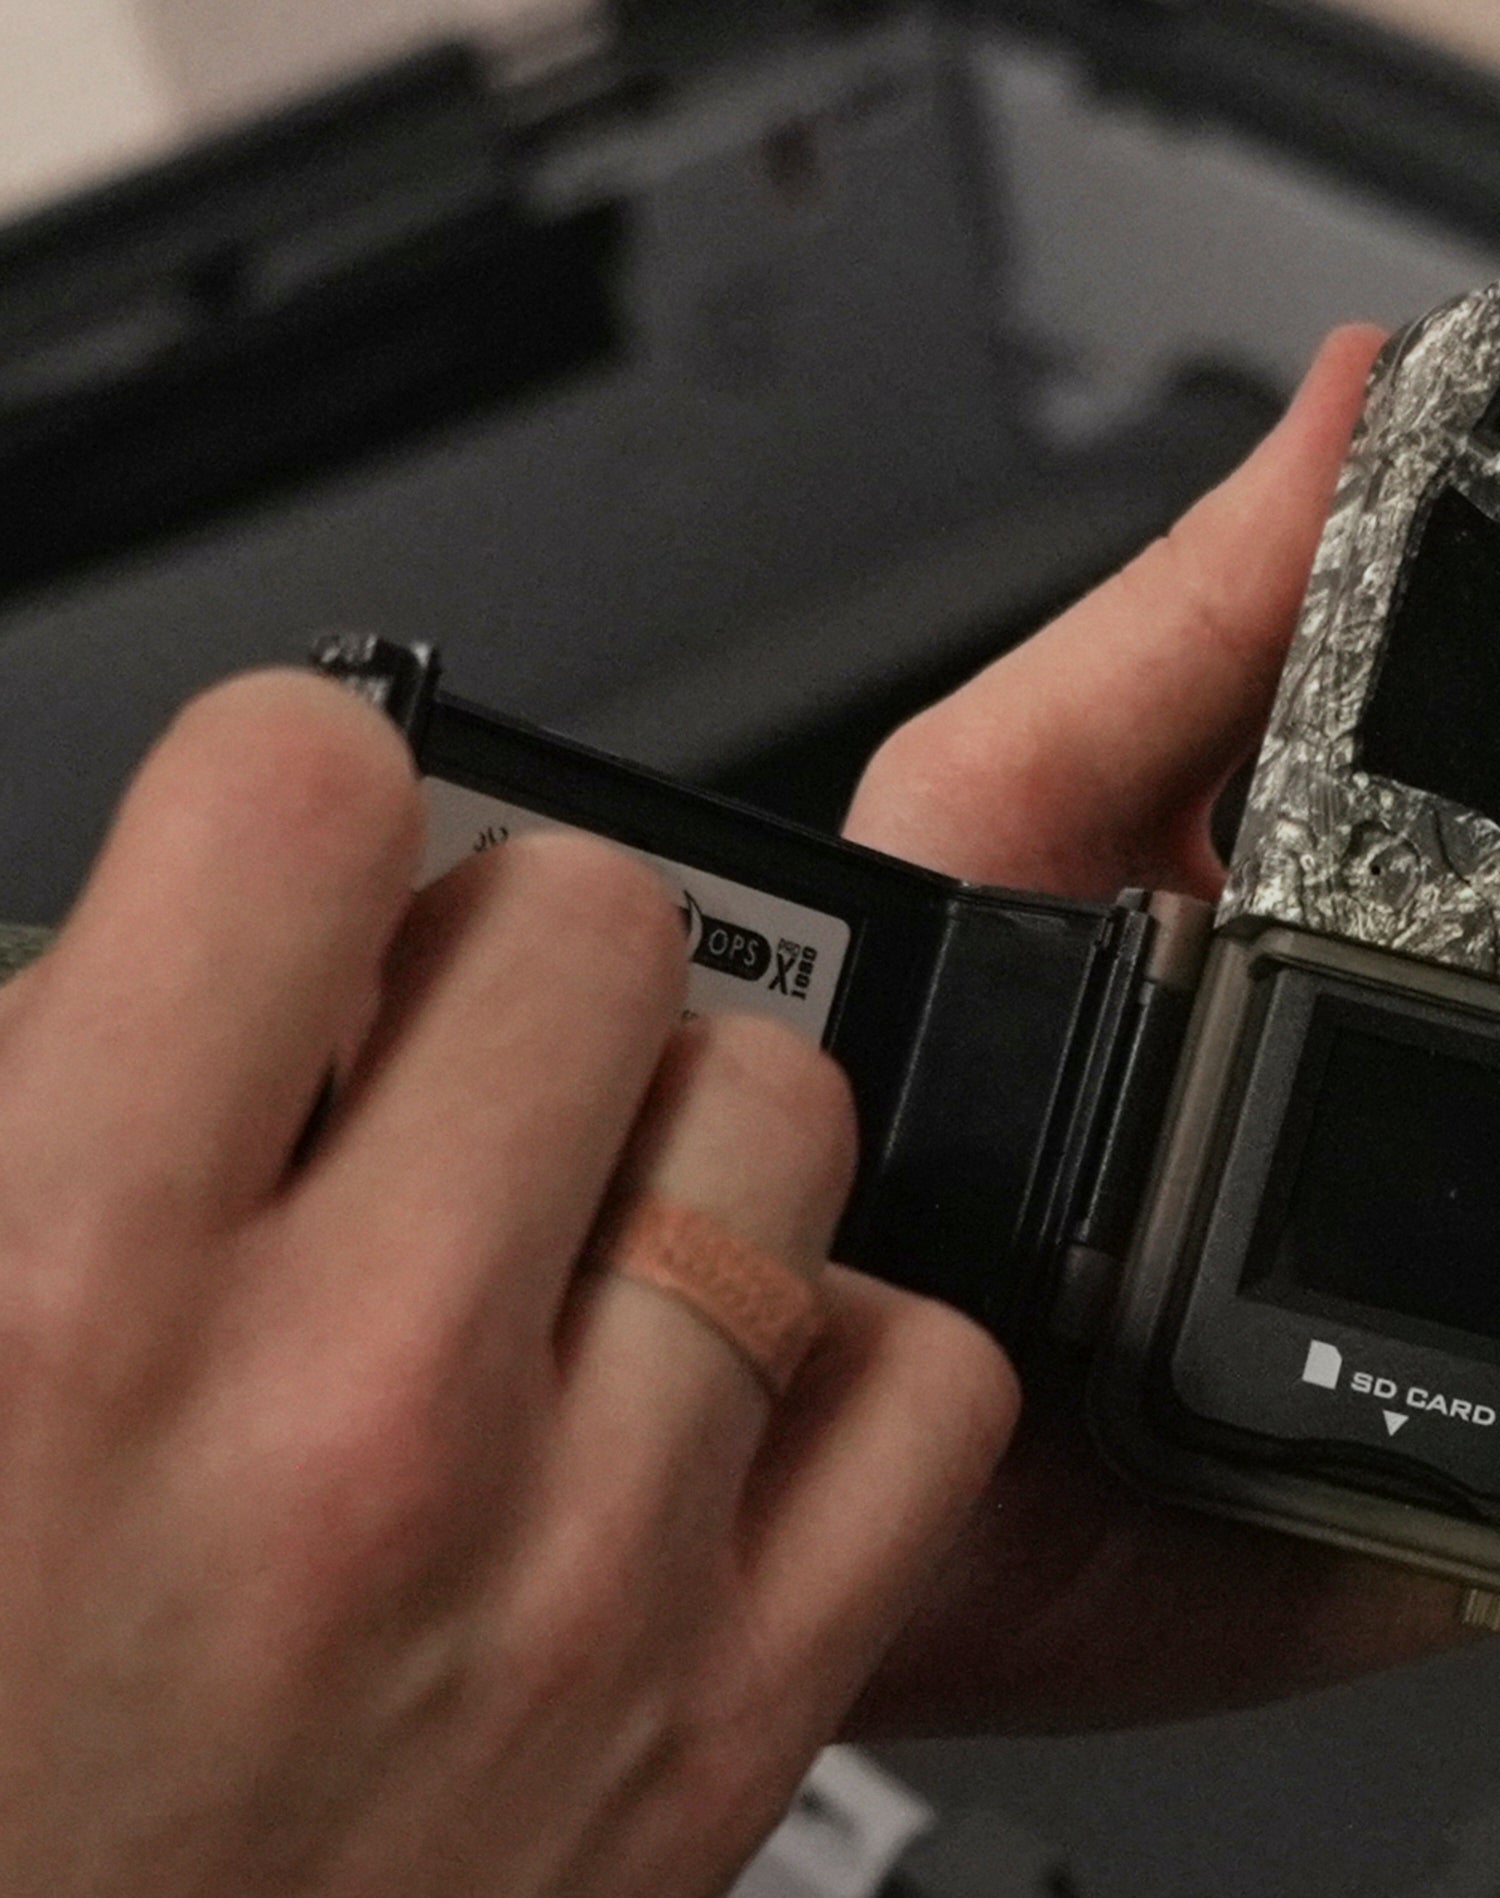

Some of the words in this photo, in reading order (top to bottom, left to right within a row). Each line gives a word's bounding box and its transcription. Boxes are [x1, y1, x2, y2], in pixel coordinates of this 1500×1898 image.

[708, 928, 759, 966] OPS
[769, 953, 796, 995] X
[1350, 1371, 1397, 1399] SD
[1406, 1387, 1496, 1426] CARD
